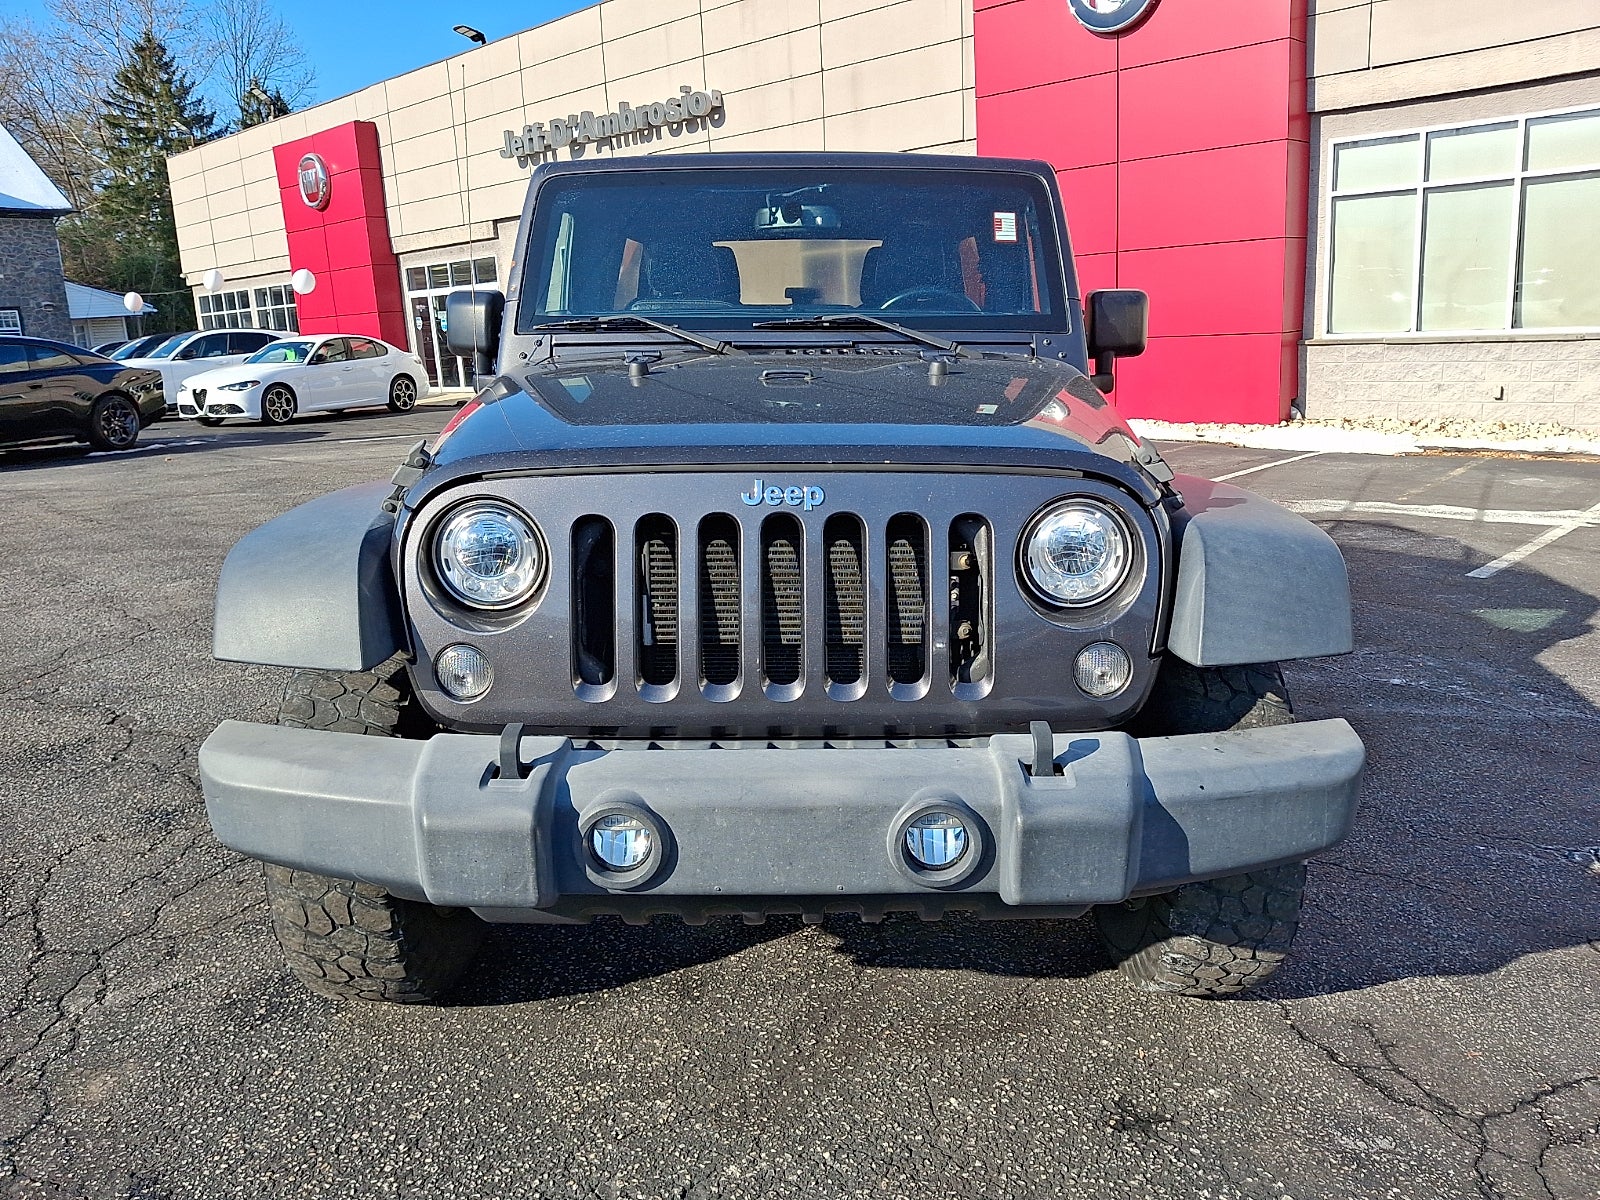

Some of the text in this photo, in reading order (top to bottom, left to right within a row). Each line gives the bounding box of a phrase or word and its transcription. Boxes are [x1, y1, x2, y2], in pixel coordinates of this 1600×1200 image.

[500, 86, 711, 158] Jeff D'Ambrosio
[741, 479, 825, 511] Jeep
